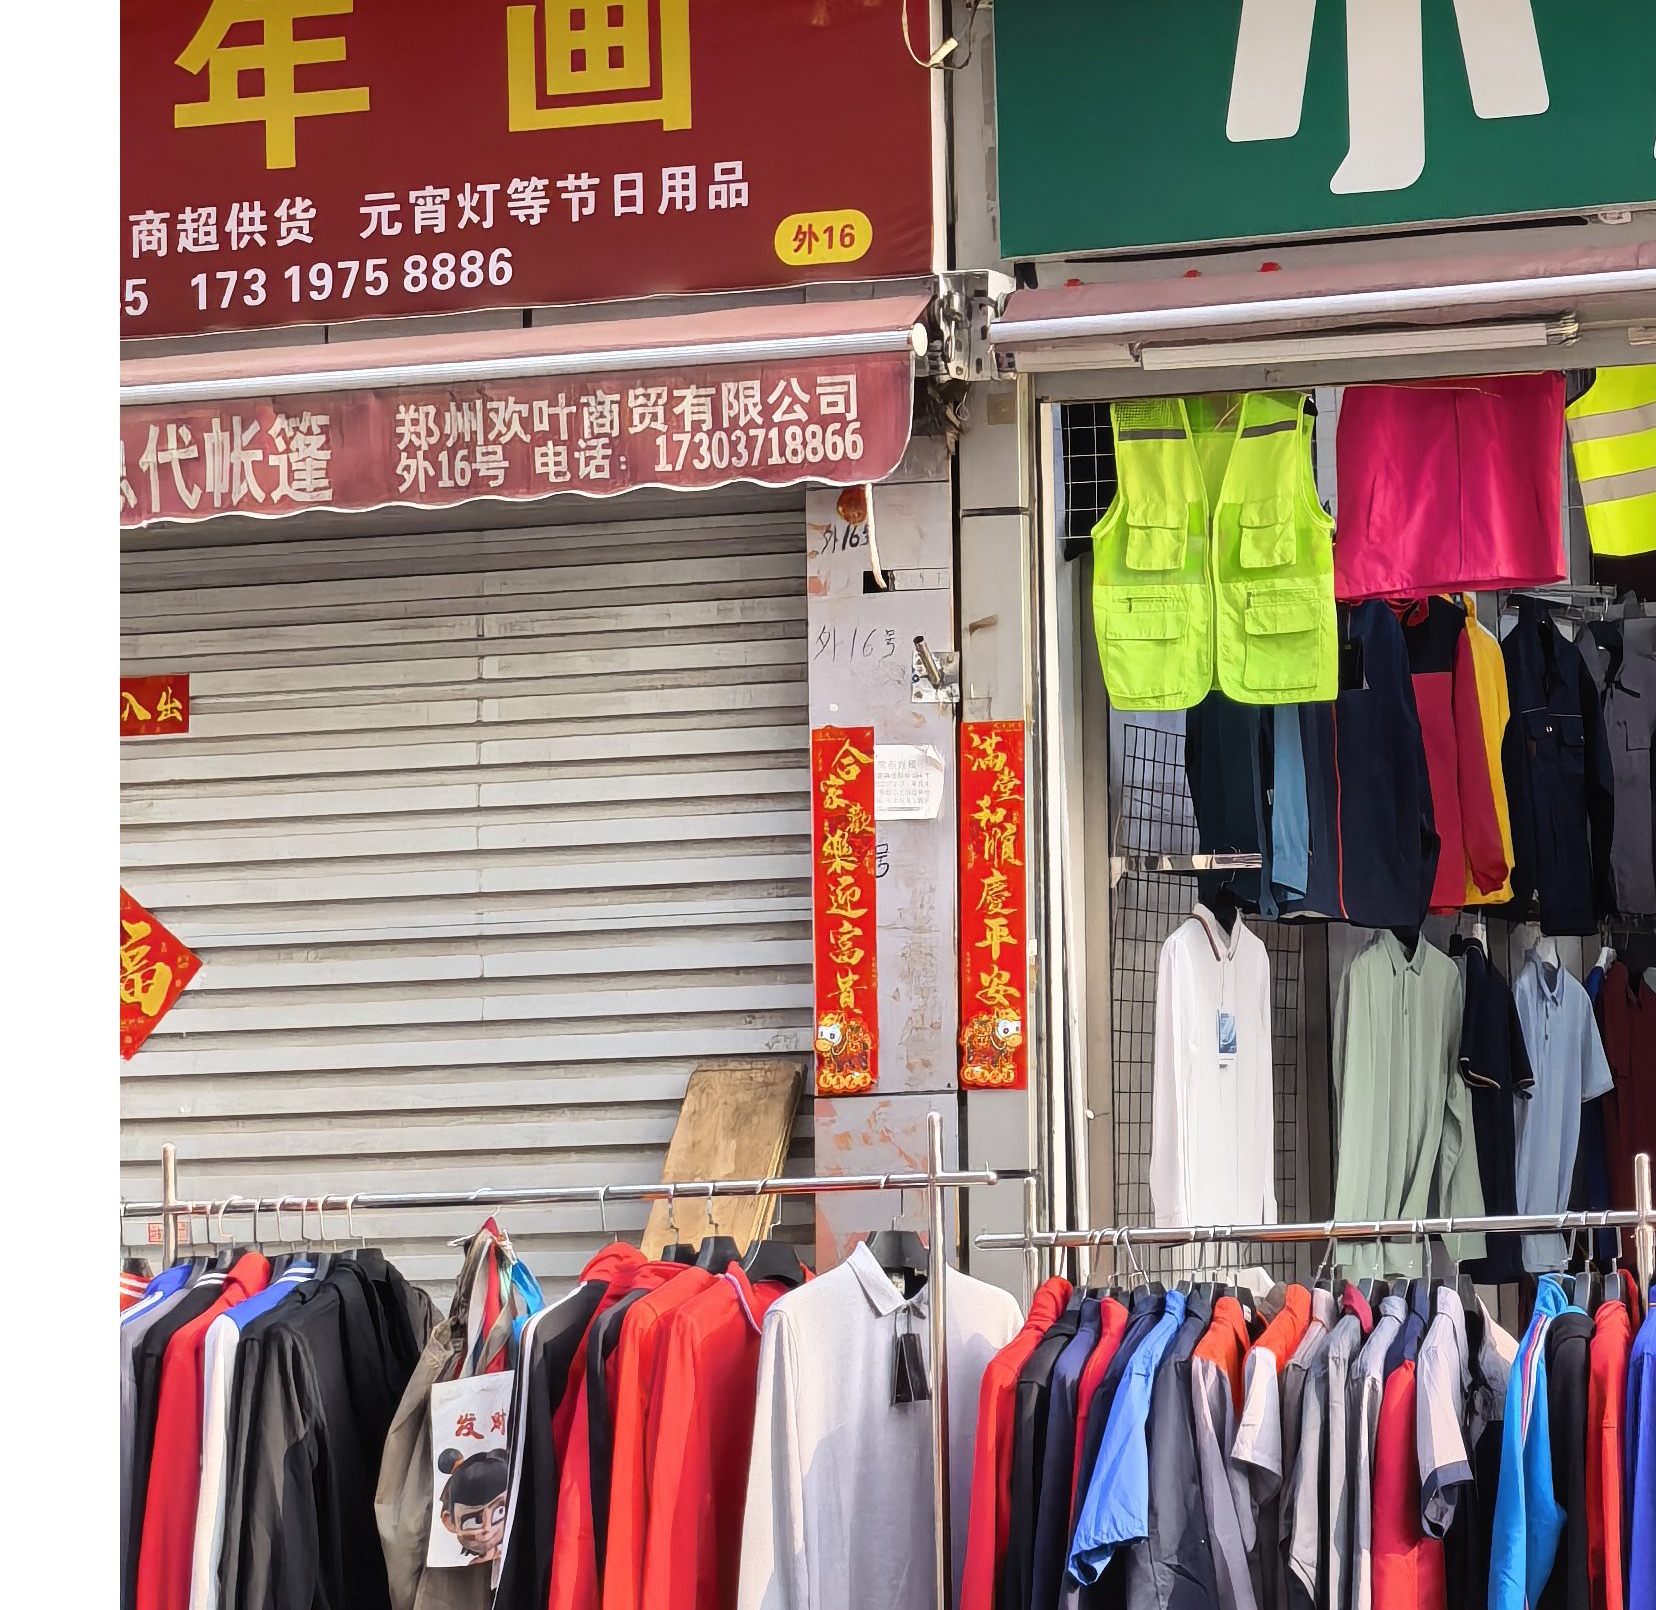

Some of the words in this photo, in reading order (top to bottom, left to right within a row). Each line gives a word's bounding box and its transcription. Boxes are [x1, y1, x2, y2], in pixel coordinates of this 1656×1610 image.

[128, 196, 317, 259] 商超供货
[359, 160, 749, 239] 元宵灯等节日用品
[792, 222, 856, 255] 外16
[120, 278, 149, 317] 5
[190, 268, 267, 311] 173
[284, 257, 389, 303] 1975
[403, 247, 513, 293] 8886
[396, 375, 858, 450] 郑州欢叶商贸有限公司
[396, 444, 509, 493] 外16号
[655, 422, 865, 472] 17303718866
